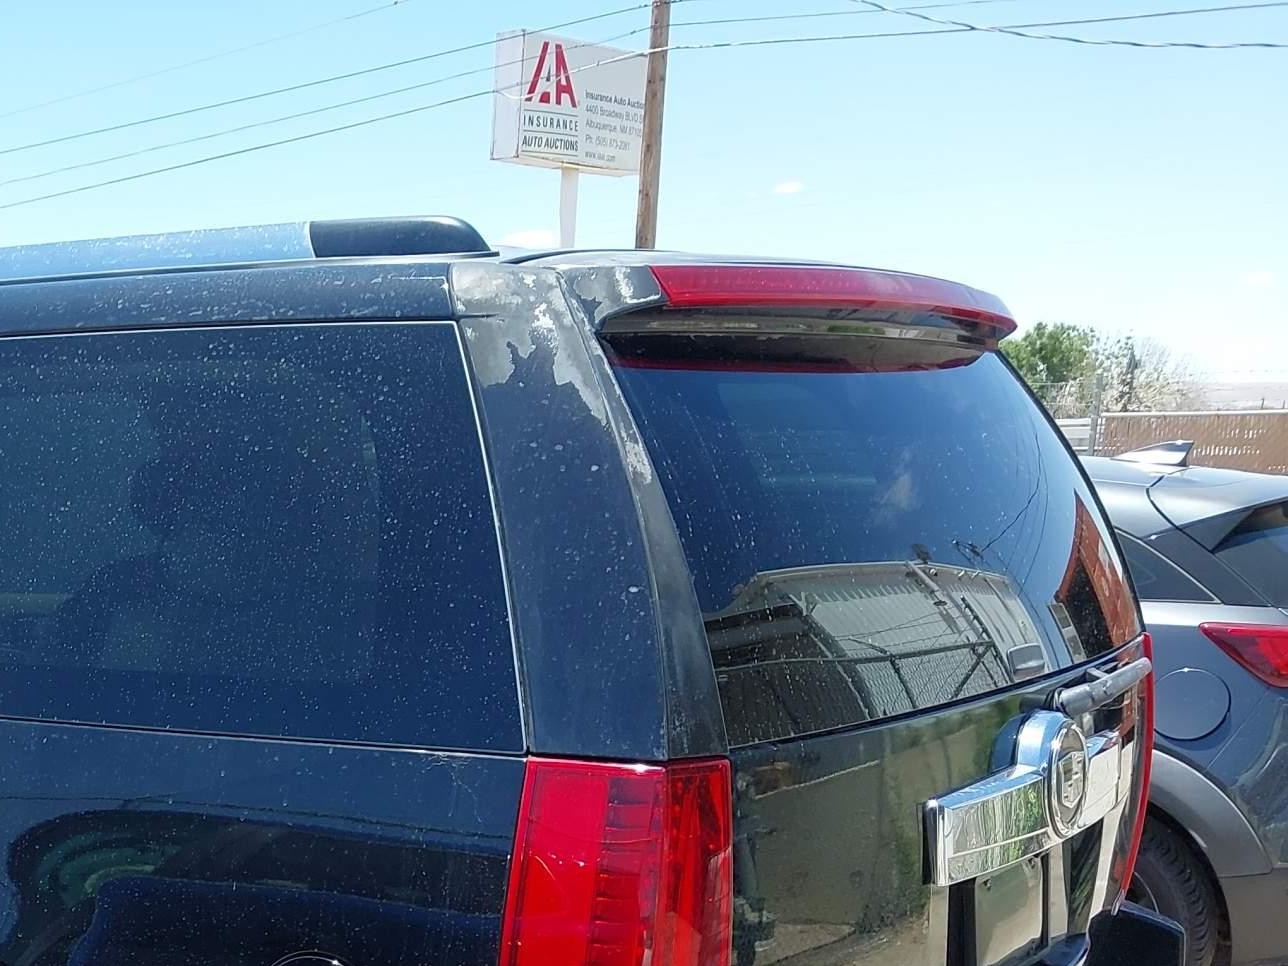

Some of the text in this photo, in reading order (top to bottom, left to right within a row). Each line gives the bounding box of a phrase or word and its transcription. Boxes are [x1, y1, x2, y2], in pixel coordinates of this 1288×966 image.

[585, 89, 613, 103] Insurance
[613, 95, 626, 106] Auto
[523, 115, 579, 132] INSURANCE
[522, 135, 579, 152] AUTO AUCTIONS
